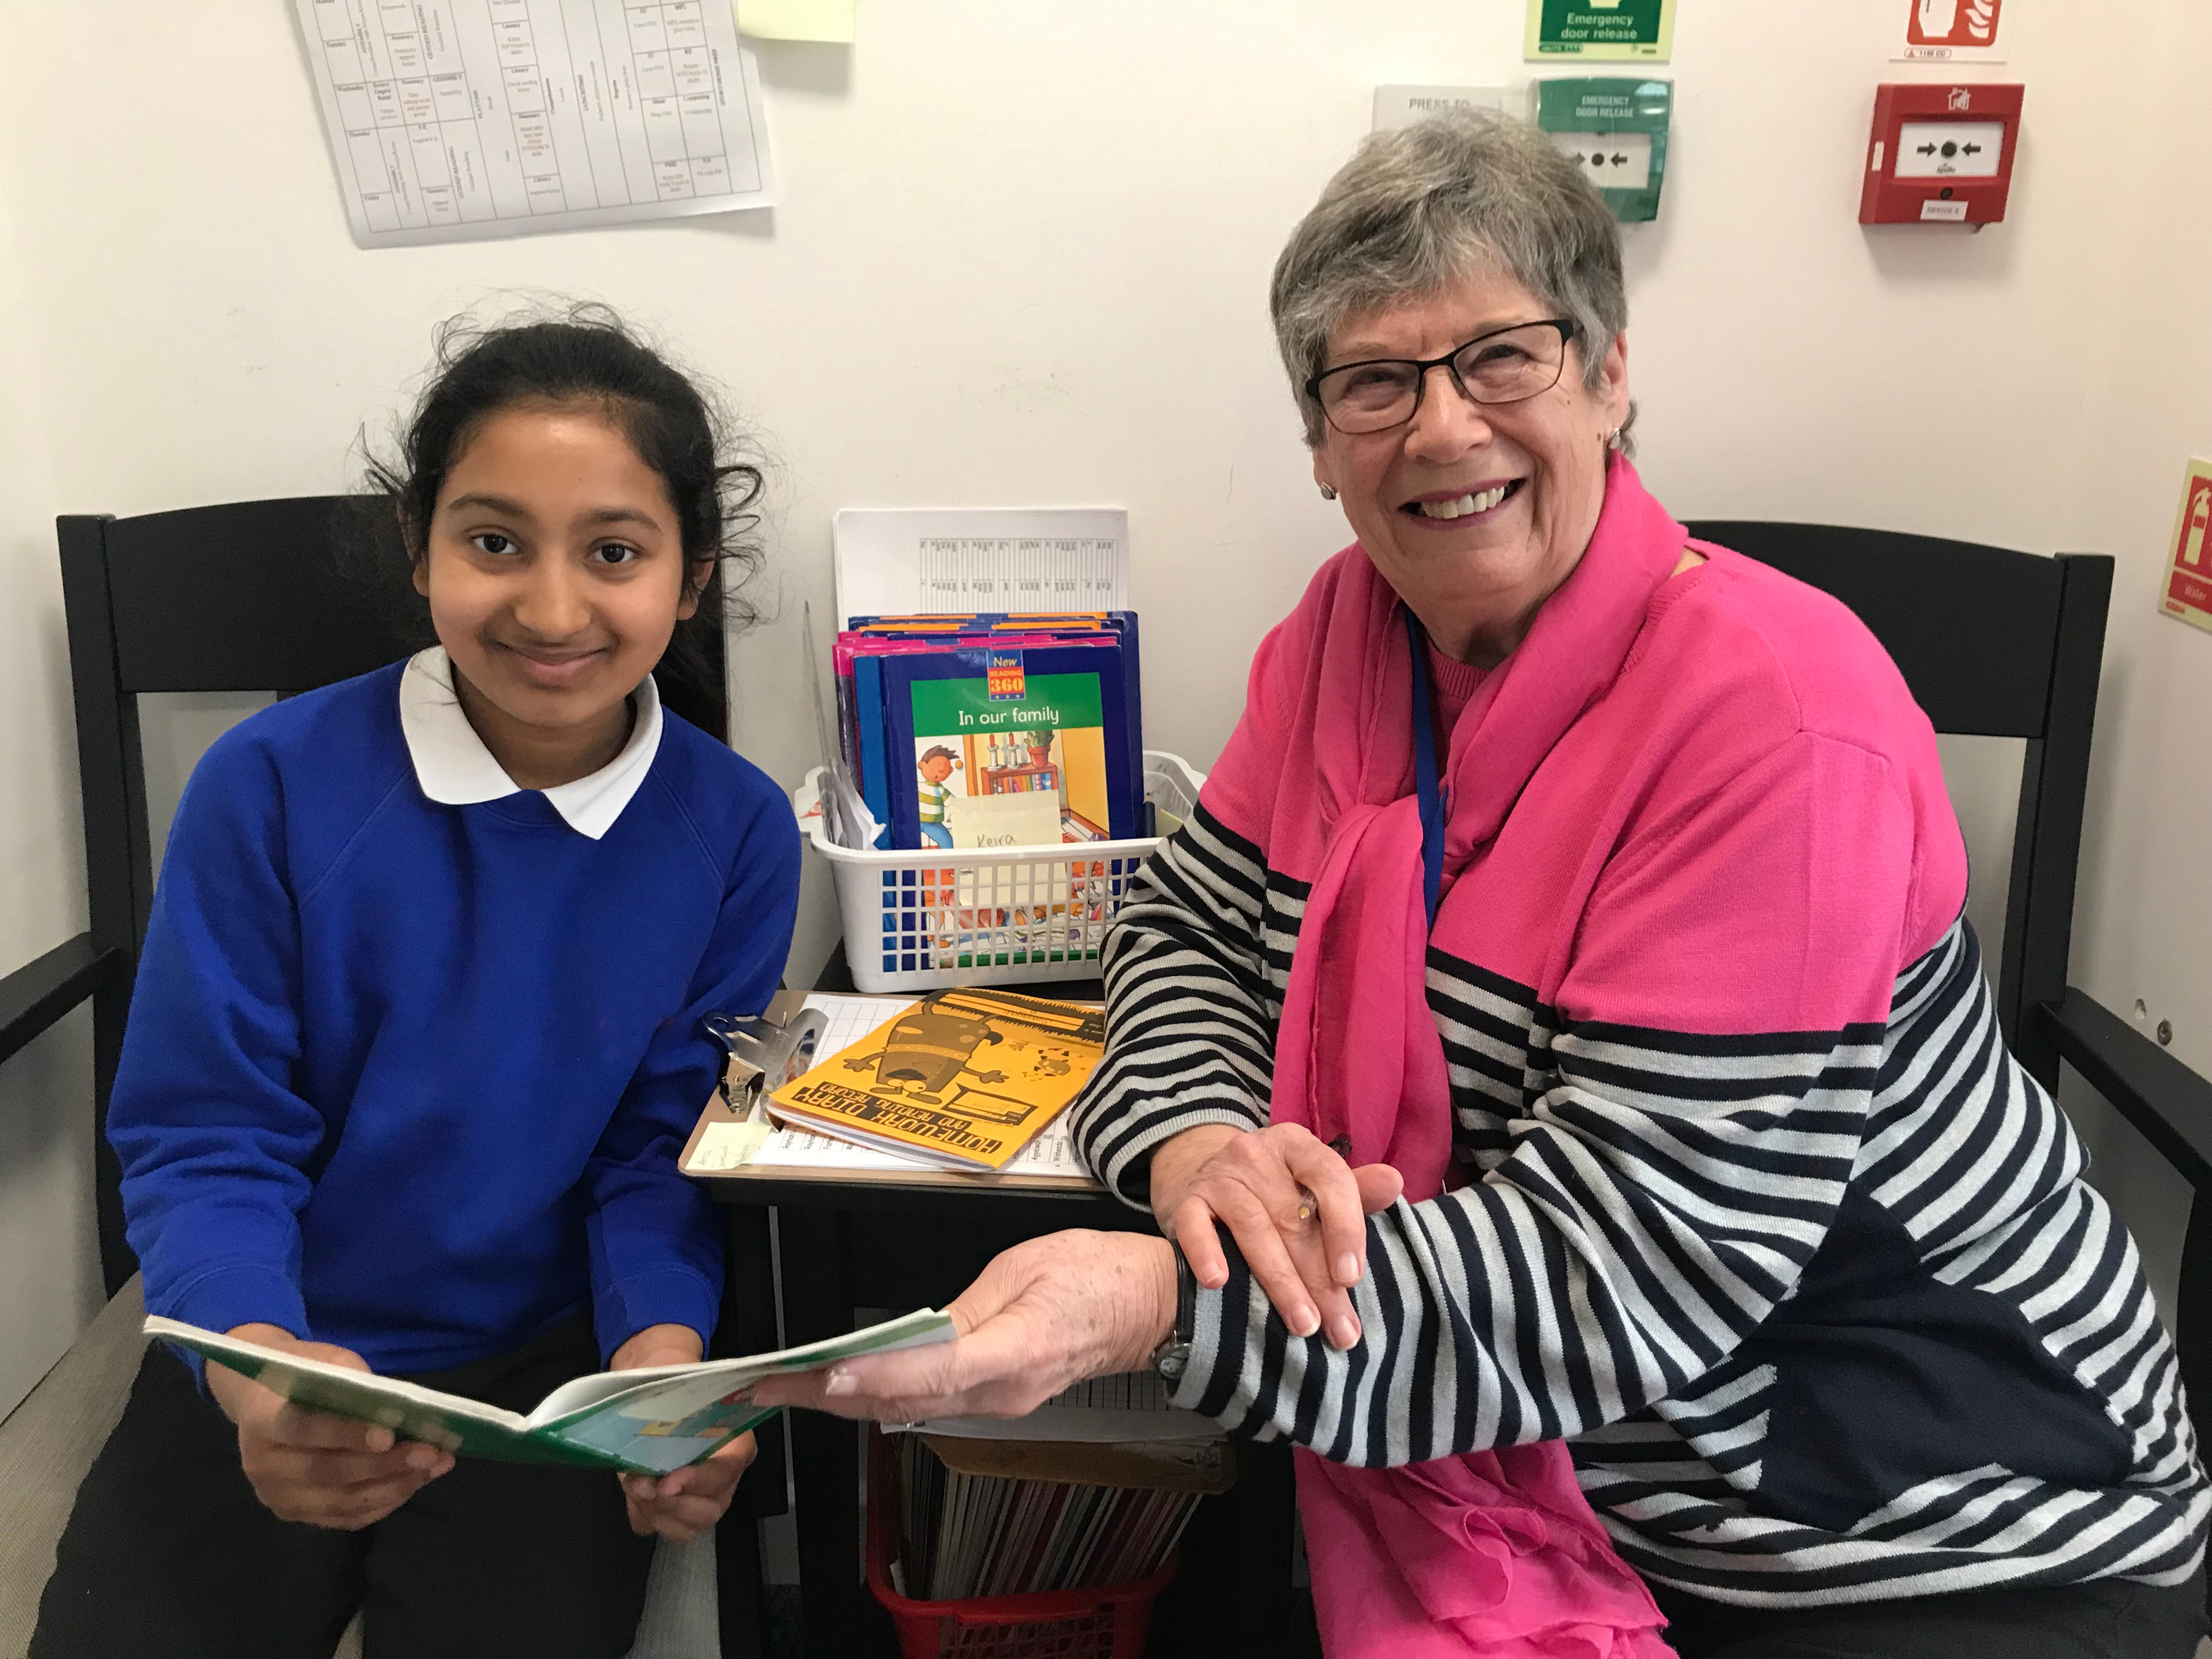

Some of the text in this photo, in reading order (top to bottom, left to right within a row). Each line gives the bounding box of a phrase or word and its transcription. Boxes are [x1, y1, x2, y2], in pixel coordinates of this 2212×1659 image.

[1567, 12, 1633, 27] Emergency
[1561, 27, 1637, 40] door release
[1409, 98, 1449, 110] PRESS
[1581, 95, 1629, 105] EMERGENCY
[1576, 106, 1633, 117] DOOR RELEASE
[2185, 584, 2207, 601] Water
[994, 656, 1018, 667] New
[990, 679, 1024, 693] 360
[959, 706, 1059, 725] In our family
[977, 832, 1016, 848] Keira
[820, 1084, 871, 1104] RECORD
[795, 1090, 867, 1116] DIARY
[874, 1099, 935, 1122] READING
[939, 1117, 968, 1130] AND
[871, 1110, 1002, 1154] HOMEWORK
